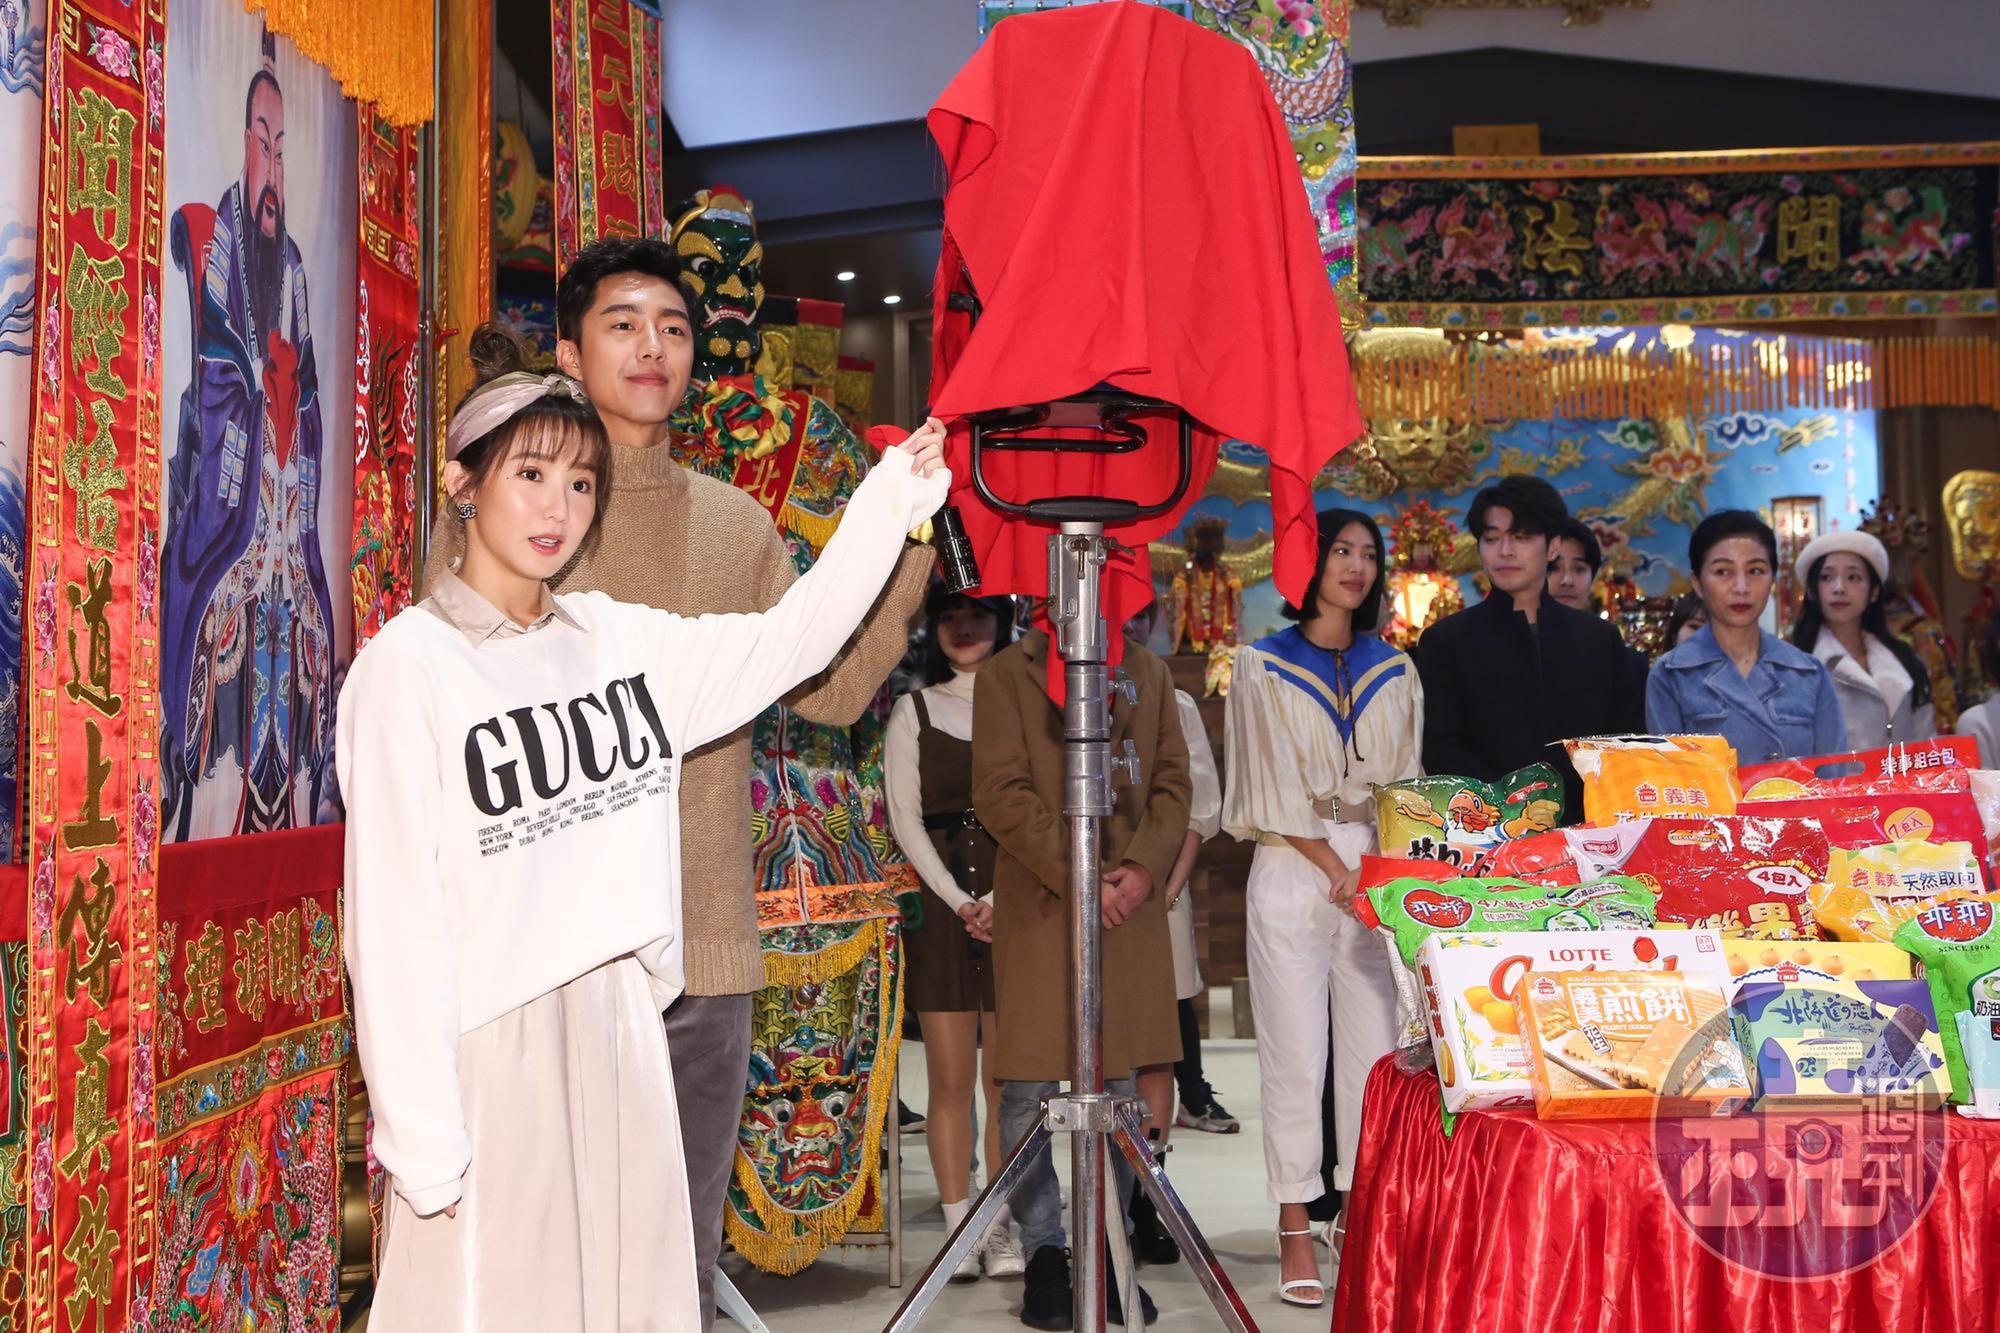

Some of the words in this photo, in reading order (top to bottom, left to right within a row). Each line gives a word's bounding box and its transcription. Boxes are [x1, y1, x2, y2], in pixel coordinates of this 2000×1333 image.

[464, 672, 673, 816] GUCCI
[478, 823, 504, 838] FIRENZE
[513, 815, 530, 828] ROMA
[538, 808, 551, 819] PARIS
[556, 797, 576, 811] LONDON
[584, 788, 606, 801] BERLIN
[635, 768, 658, 783] ATHENS
[479, 836, 493, 847] NEW
[496, 831, 514, 844] YORK
[570, 802, 596, 815] CHICAGO
[615, 783, 648, 801] FRANCISCO
[1664, 787, 1707, 806] 義美
[481, 844, 509, 858] MOSCOW
[519, 835, 536, 847] DUBAI
[610, 796, 640, 814] SHANGHAI
[1757, 870, 1802, 888] 4包入
[1924, 901, 1987, 931] 乖乖
[1549, 949, 1613, 962] LOTTE
